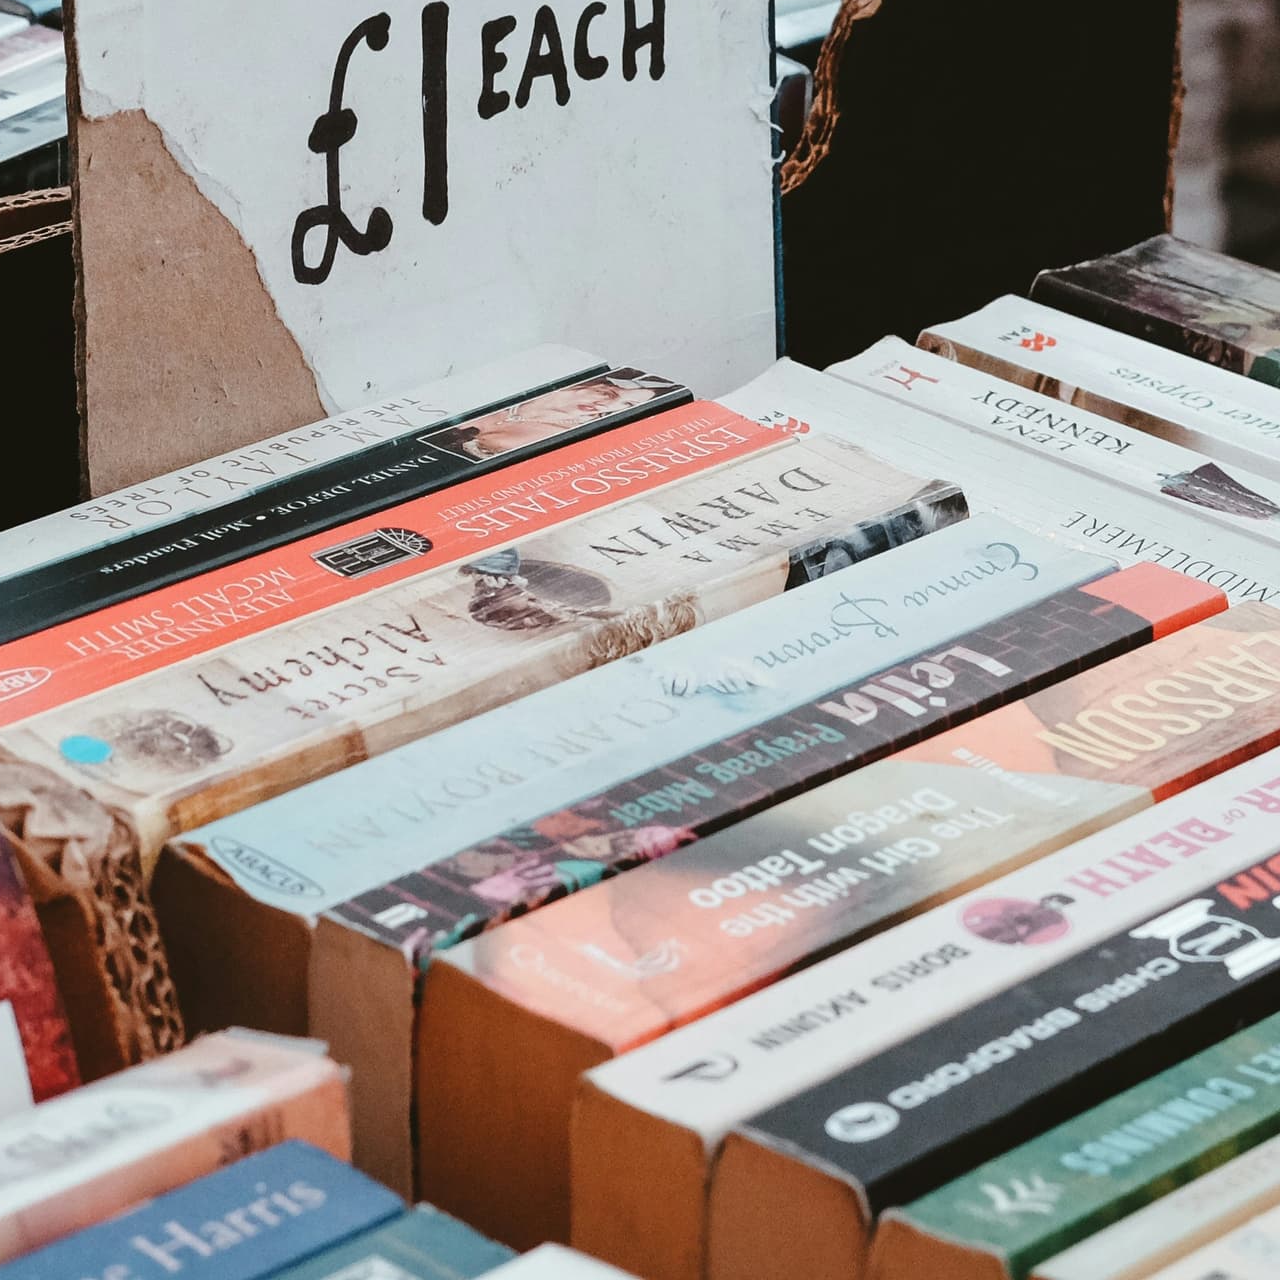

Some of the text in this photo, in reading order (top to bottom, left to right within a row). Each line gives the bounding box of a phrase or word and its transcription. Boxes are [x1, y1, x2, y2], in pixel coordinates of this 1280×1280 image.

[291, 1, 450, 286] £1
[697, 416, 721, 435] THE
[971, 389, 1134, 457] KENNEDY
[992, 414, 1076, 453] LENA
[1109, 366, 1213, 410] Gypsies
[71, 396, 422, 523] THE REPUBLIC OF TREES
[103, 403, 449, 532] SAM TAYLOR
[455, 424, 749, 539] ESPRESSO TALES
[492, 465, 579, 502] SCOTLAND
[597, 441, 648, 464] FROM
[649, 428, 698, 449] LATEST
[100, 453, 440, 576] DANIEL DEFOE Moll Flanders
[437, 495, 489, 521] STREET
[589, 465, 831, 567] DARWIN
[681, 505, 832, 564] EMMA
[1060, 509, 1280, 603] MIDDLEMERE
[67, 566, 298, 657] McCALL SMITH
[126, 587, 295, 662] ALEXANDER
[751, 540, 1040, 673] Emma Brown
[196, 615, 434, 705] Alchemy
[285, 653, 449, 721] A Secret
[816, 643, 1015, 727] Leila
[307, 694, 683, 857] CLARE BOYLAN
[608, 722, 848, 829] Prayaag Akbar
[1219, 806, 1249, 826] OF
[224, 841, 309, 898] ABACUS
[687, 785, 961, 912] Dragon Tattoo
[720, 804, 1017, 939] The Girl with the
[1066, 817, 1232, 899] DEATH
[750, 941, 971, 1053] BORIS AKUNIN
[887, 955, 1182, 1109] CHRIS BRADFORD
[1061, 1077, 1258, 1177] CUMMINGS
[130, 1180, 327, 1275] Harris
